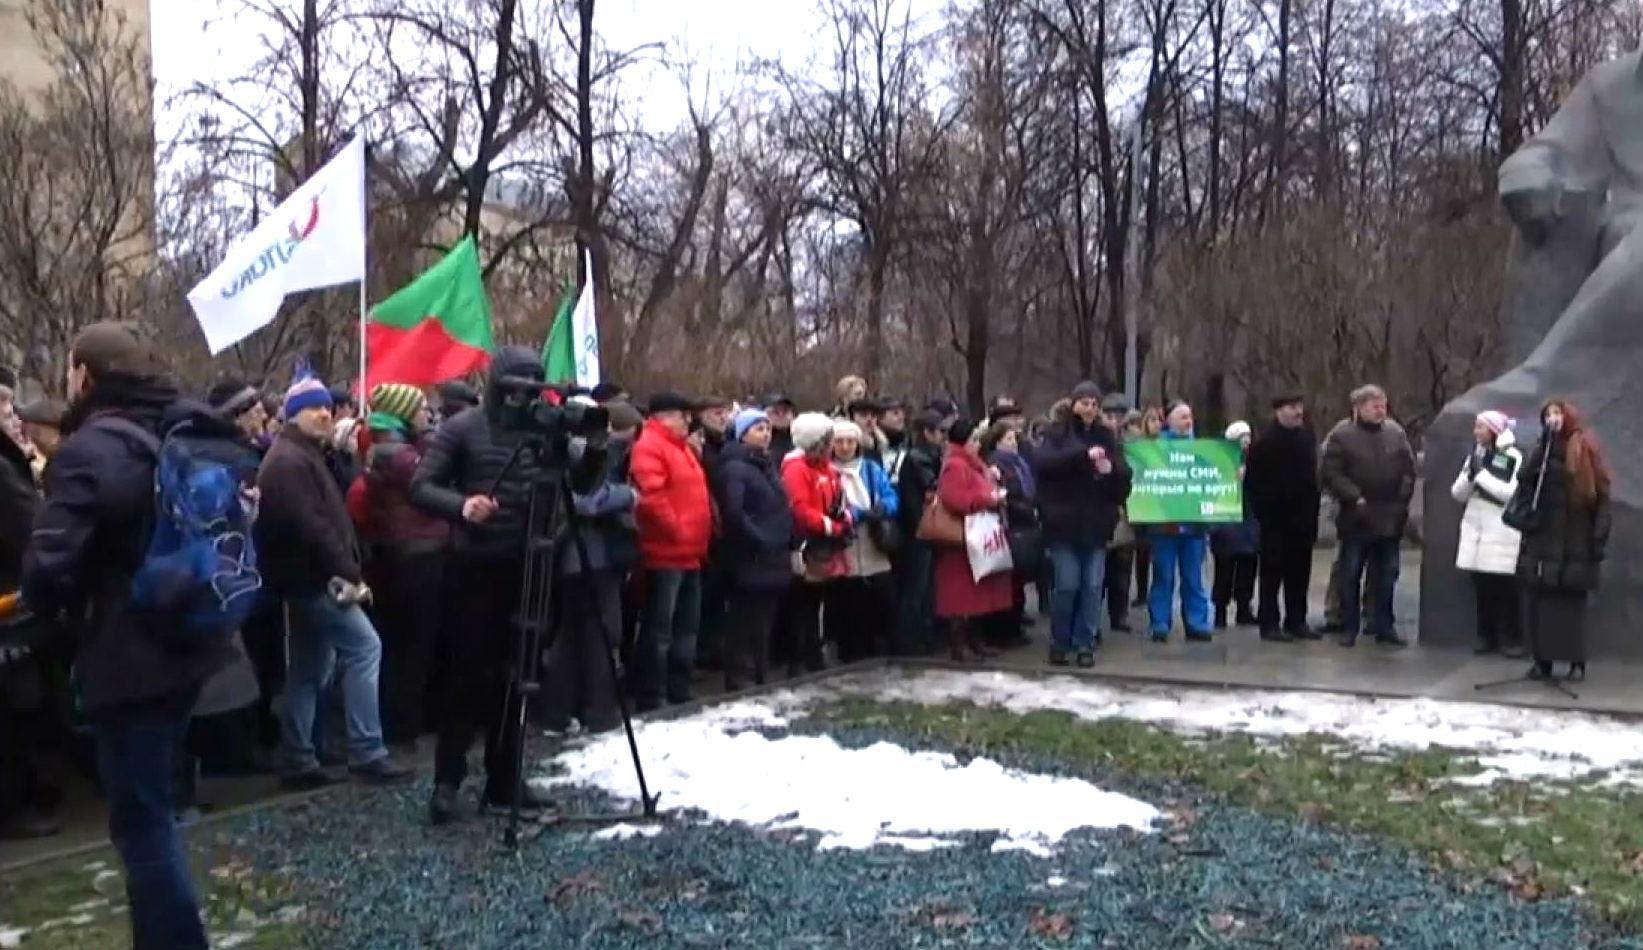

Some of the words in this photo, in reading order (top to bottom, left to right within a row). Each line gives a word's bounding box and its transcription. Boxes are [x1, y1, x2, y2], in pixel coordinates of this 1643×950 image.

[1169, 451, 1196, 463] Нам
[1143, 467, 1188, 481] нужны
[1190, 466, 1222, 480] СМИ,
